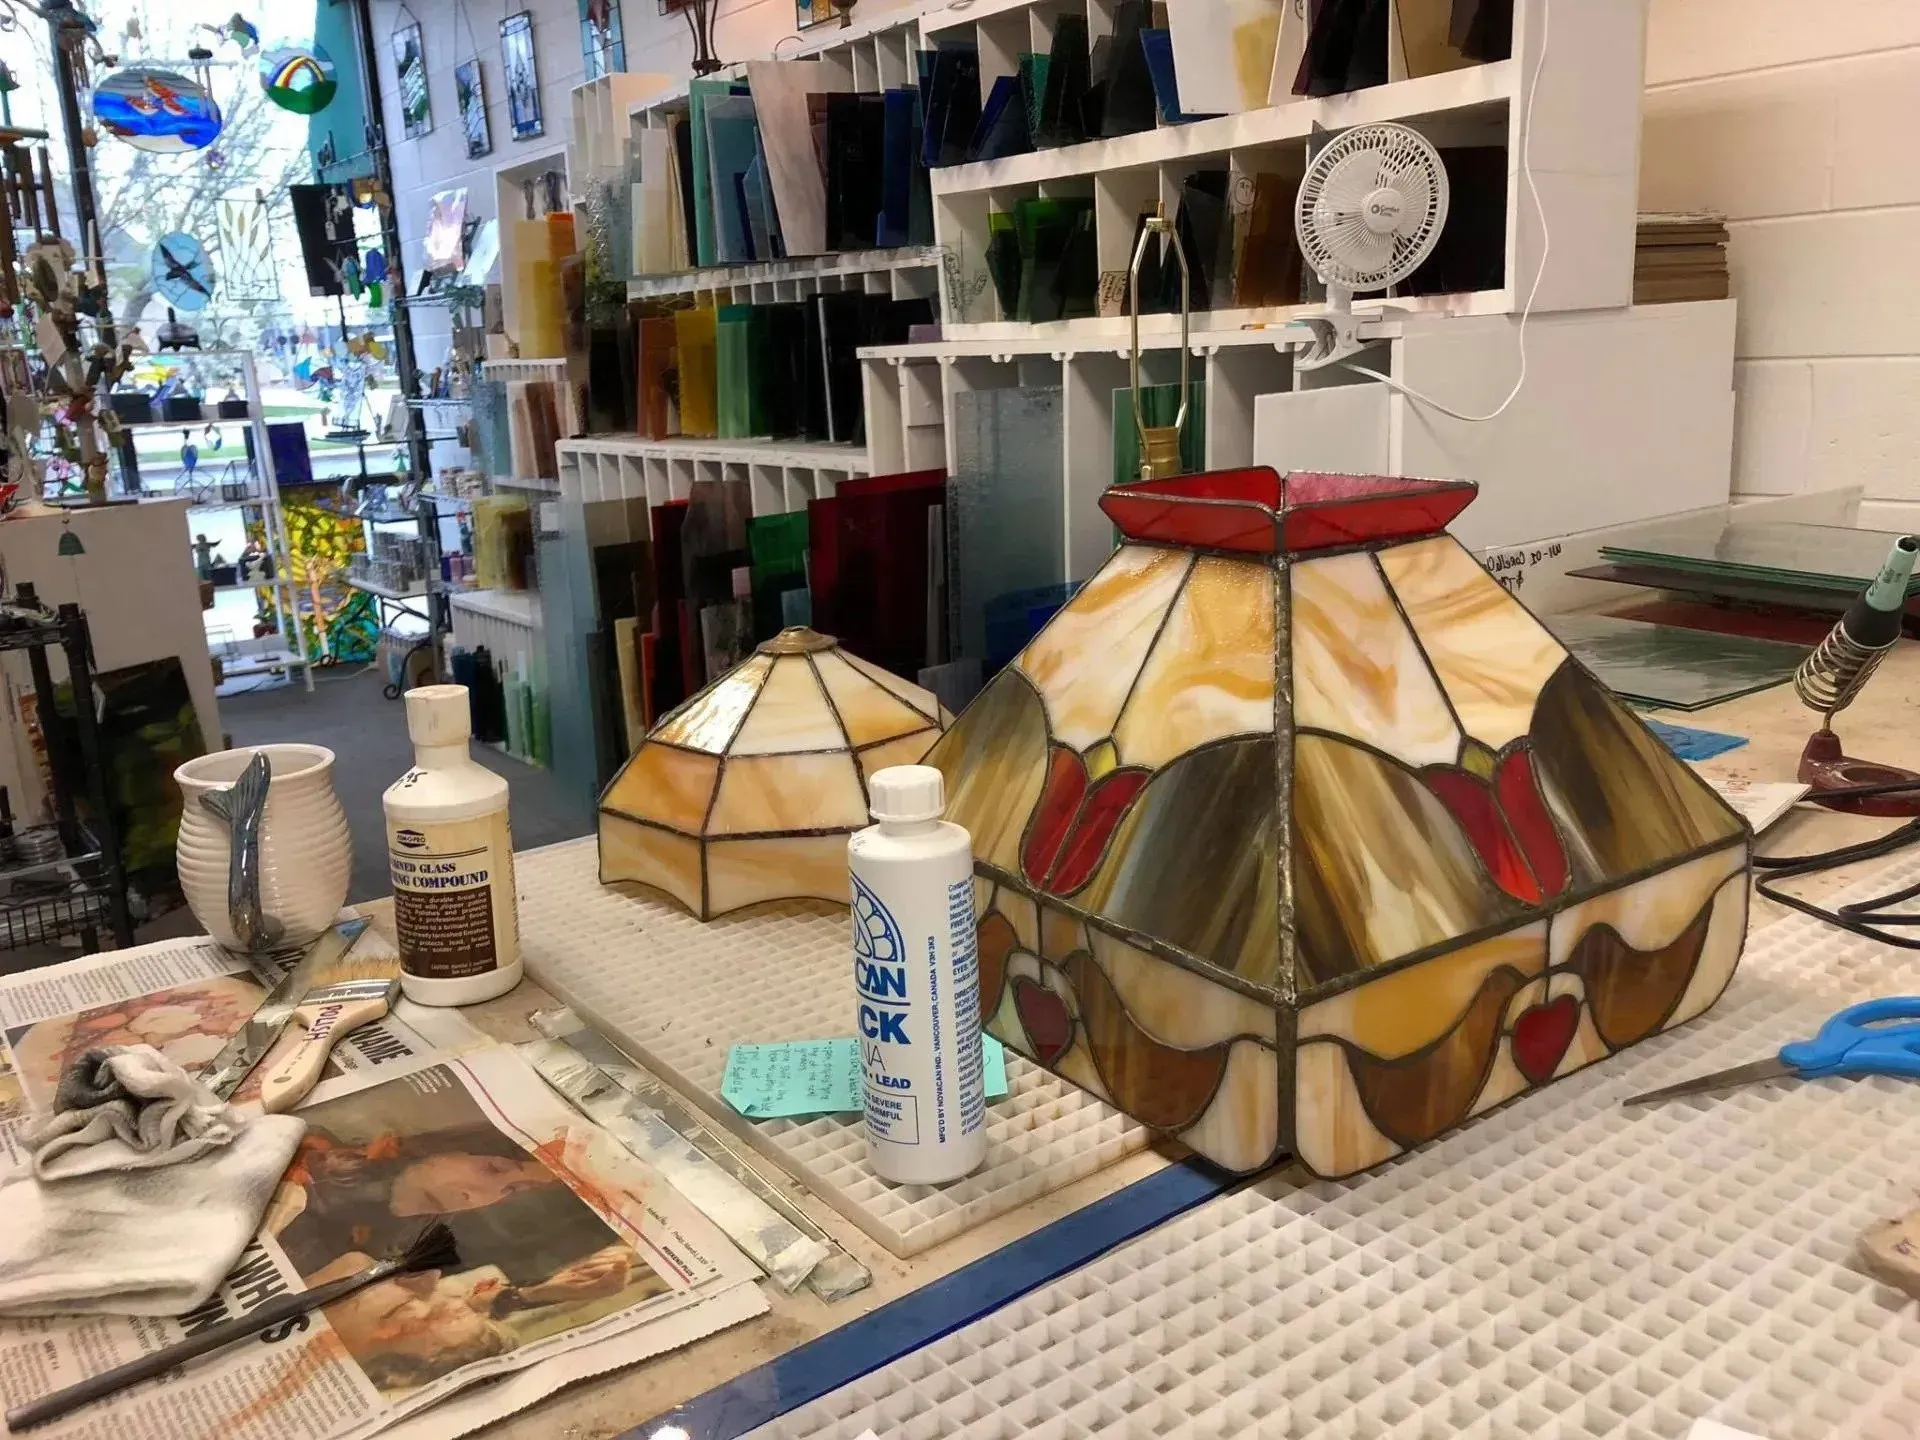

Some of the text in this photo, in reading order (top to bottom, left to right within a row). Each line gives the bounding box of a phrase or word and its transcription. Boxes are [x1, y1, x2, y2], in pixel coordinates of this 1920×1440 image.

[420, 863, 456, 873] GLASS
[412, 870, 488, 888] COMPOUND
[930, 970, 939, 1001] CANADA
[303, 1004, 343, 1041] POLISH
[876, 1074, 911, 1089] LEAD
[936, 1071, 945, 1107] NOVACAN
[870, 1094, 903, 1110] SEVERE
[938, 1109, 945, 1118] BY
[662, 1245, 695, 1277] WEEKEND PLUS
